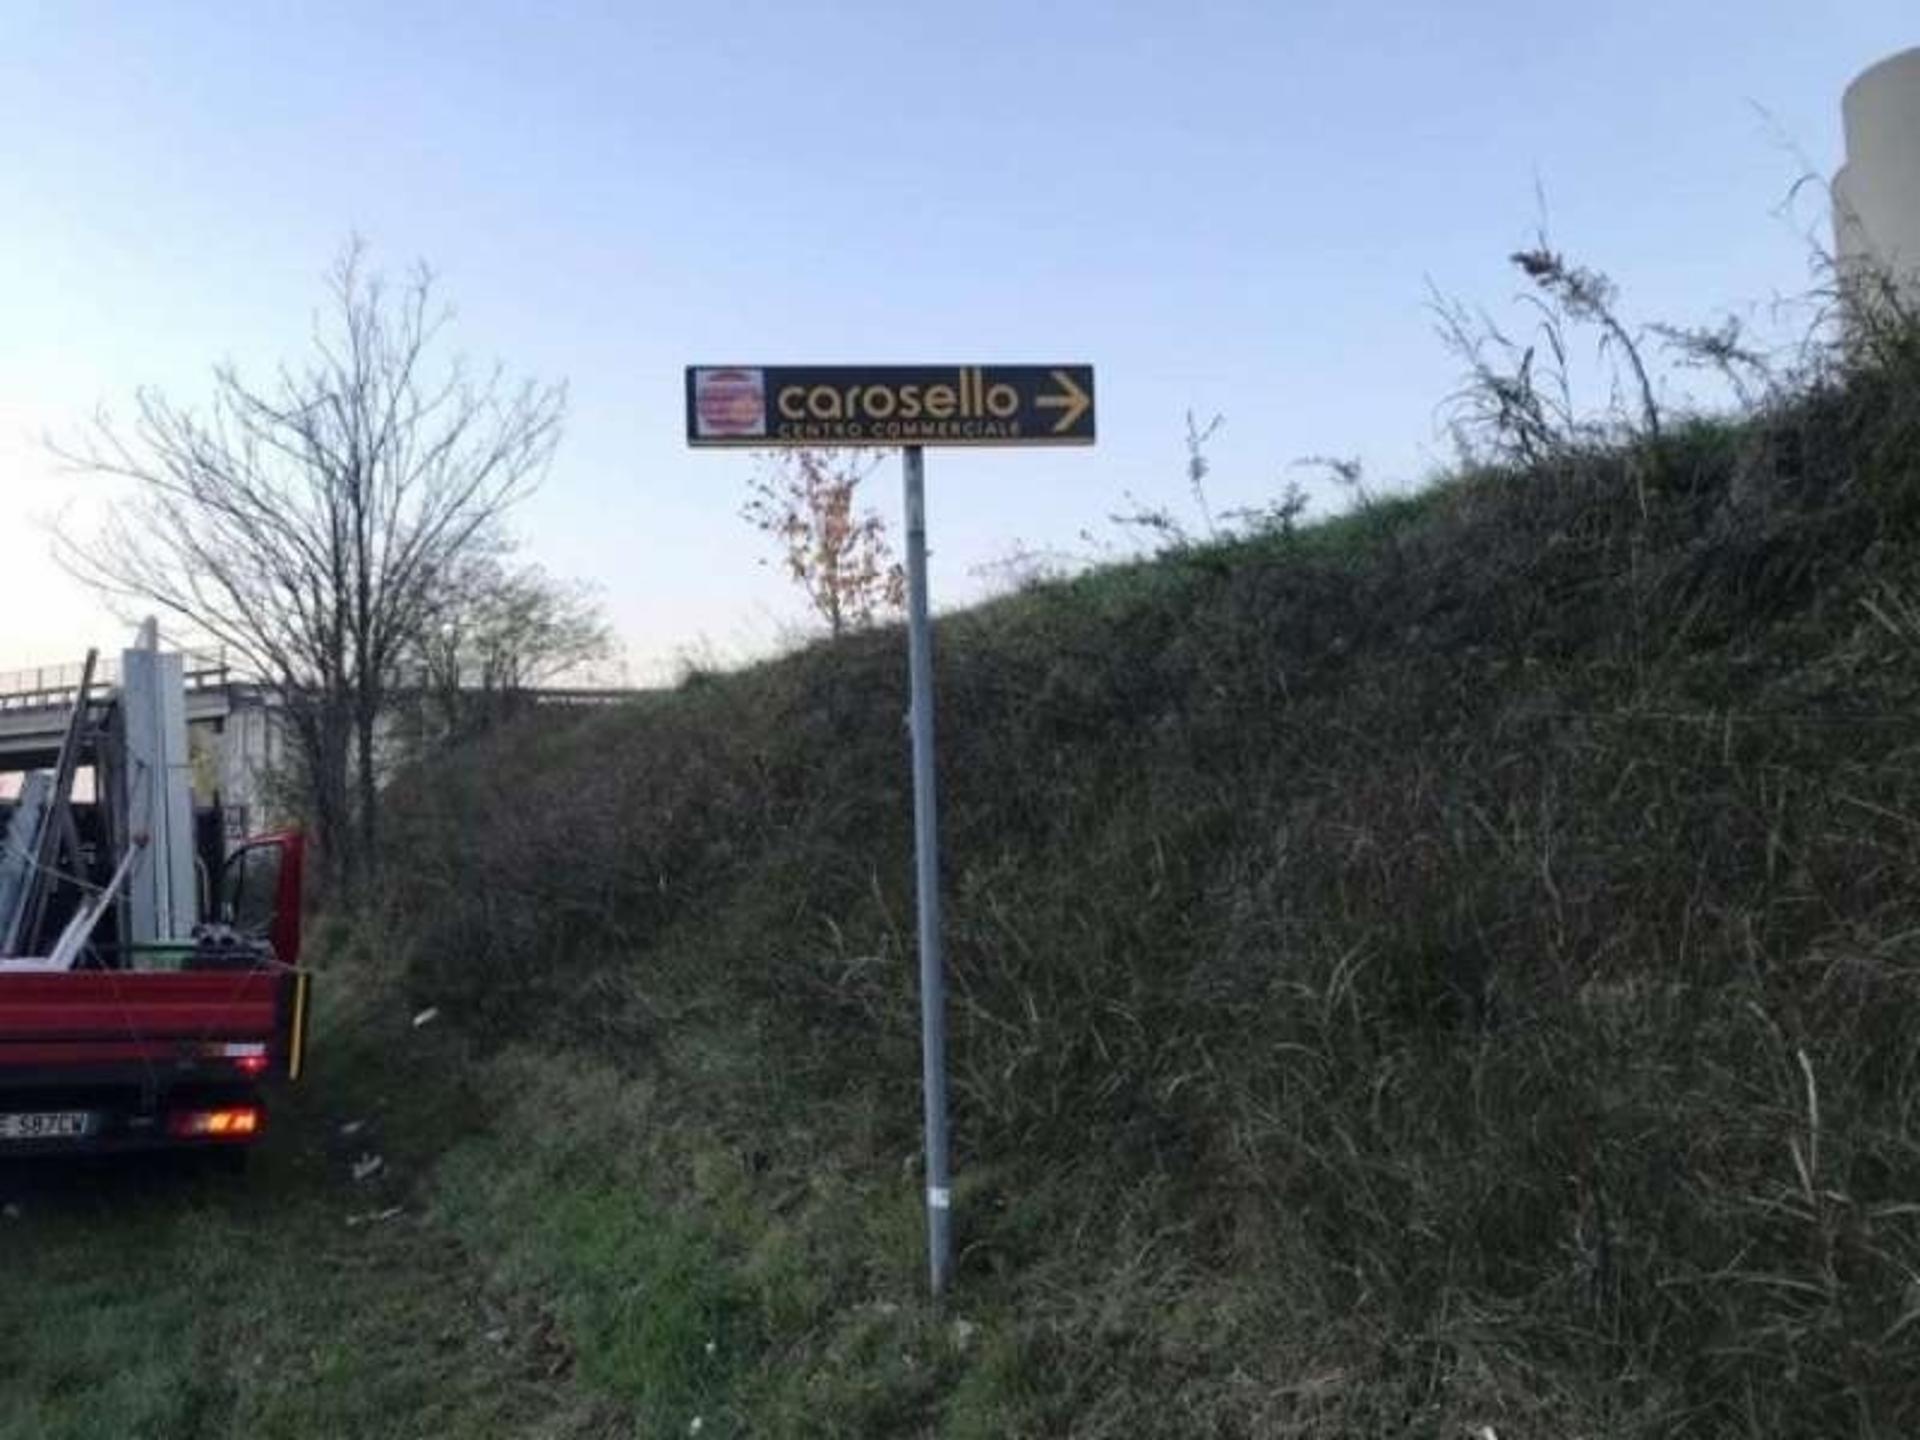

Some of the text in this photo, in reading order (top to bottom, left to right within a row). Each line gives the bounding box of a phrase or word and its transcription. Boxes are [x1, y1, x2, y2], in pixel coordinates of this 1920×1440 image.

[778, 366, 1019, 418] carosello
[777, 421, 1021, 438] CENTRO COMMERCIALE
